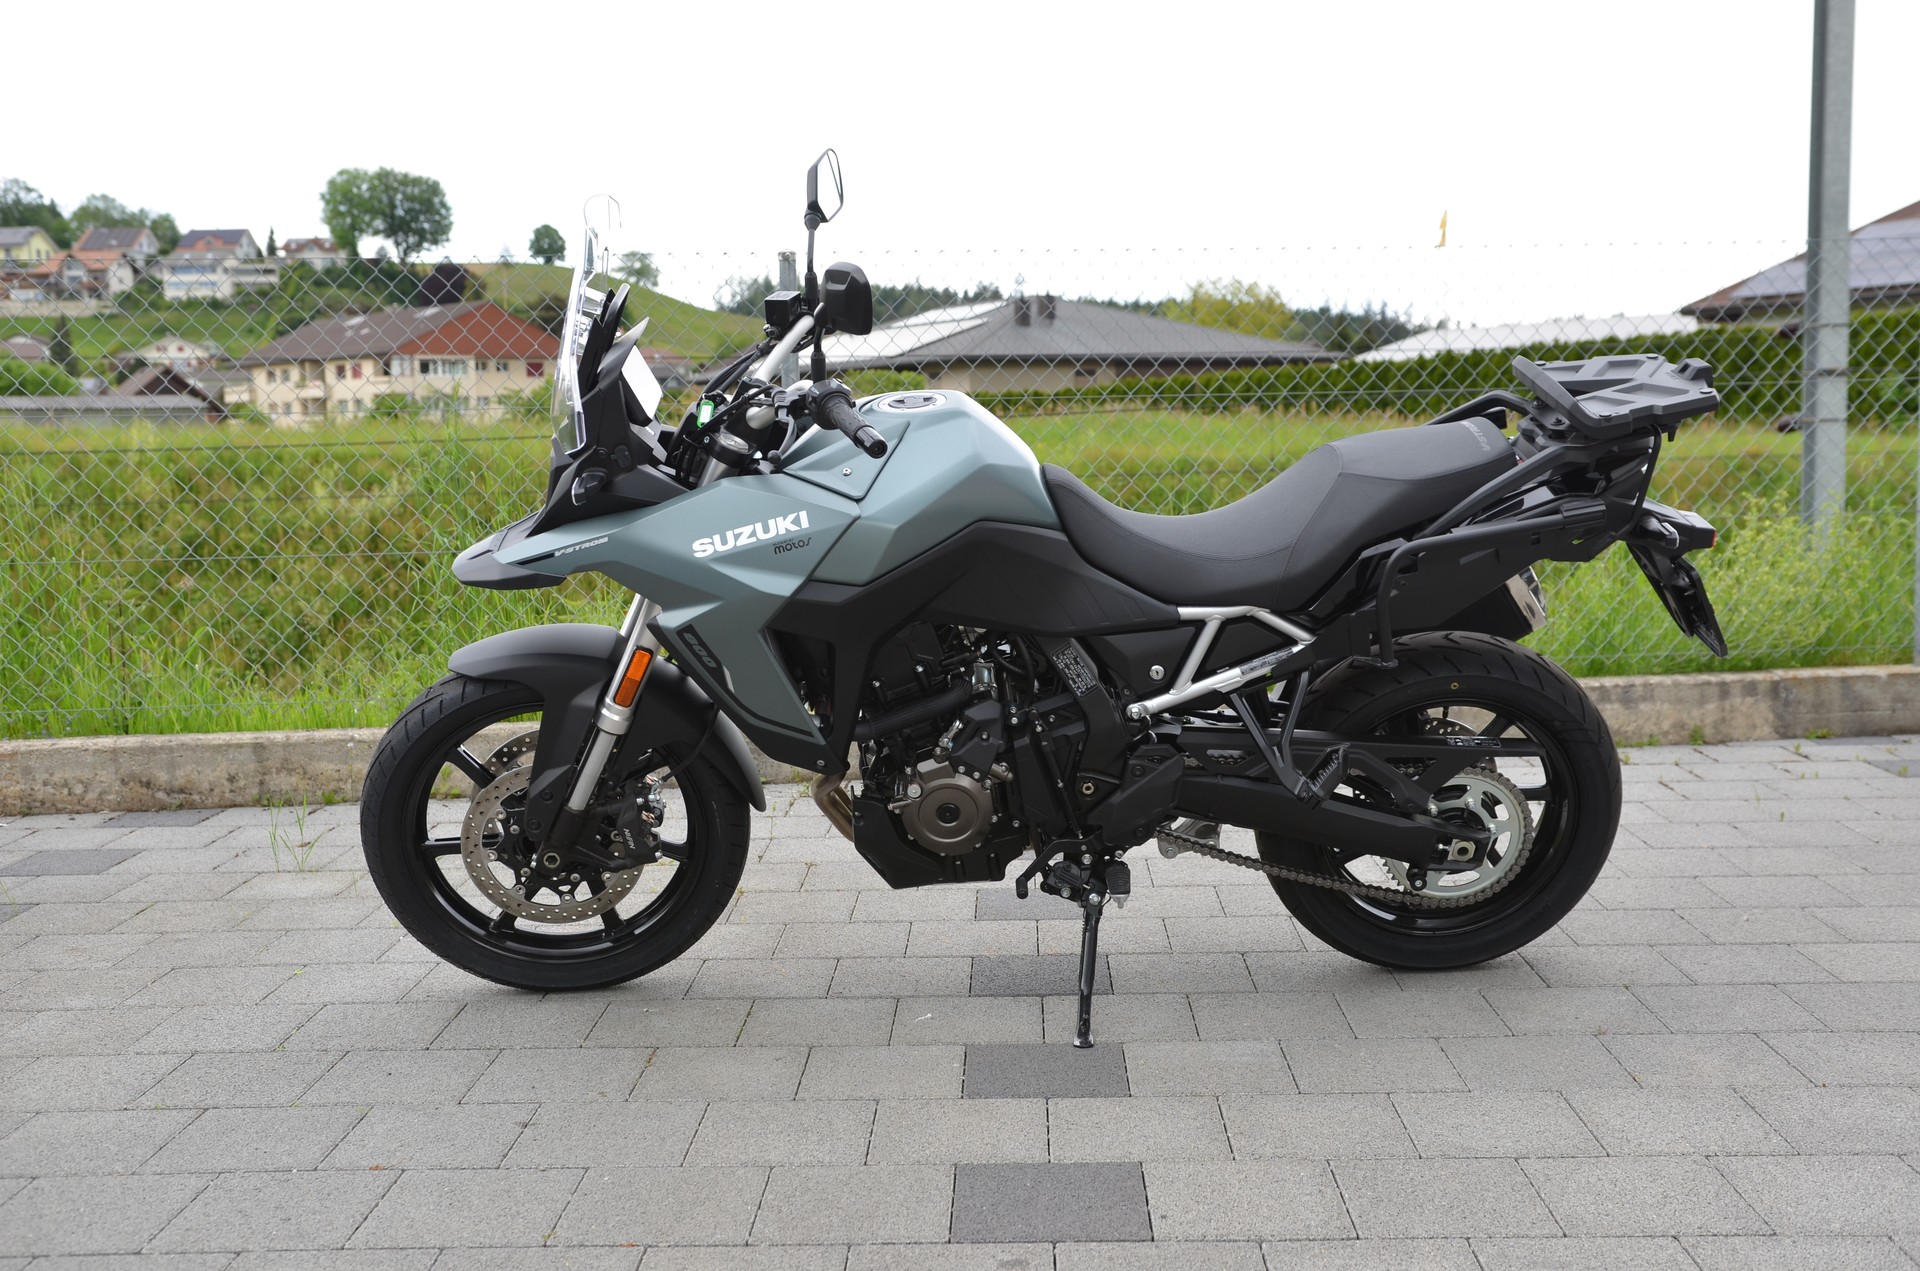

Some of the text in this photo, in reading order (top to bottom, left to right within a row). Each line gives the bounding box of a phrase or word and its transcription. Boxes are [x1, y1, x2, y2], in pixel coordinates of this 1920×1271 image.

[691, 510, 810, 558] SUZUKI
[773, 537, 811, 555] motos
[683, 632, 718, 668] 800
